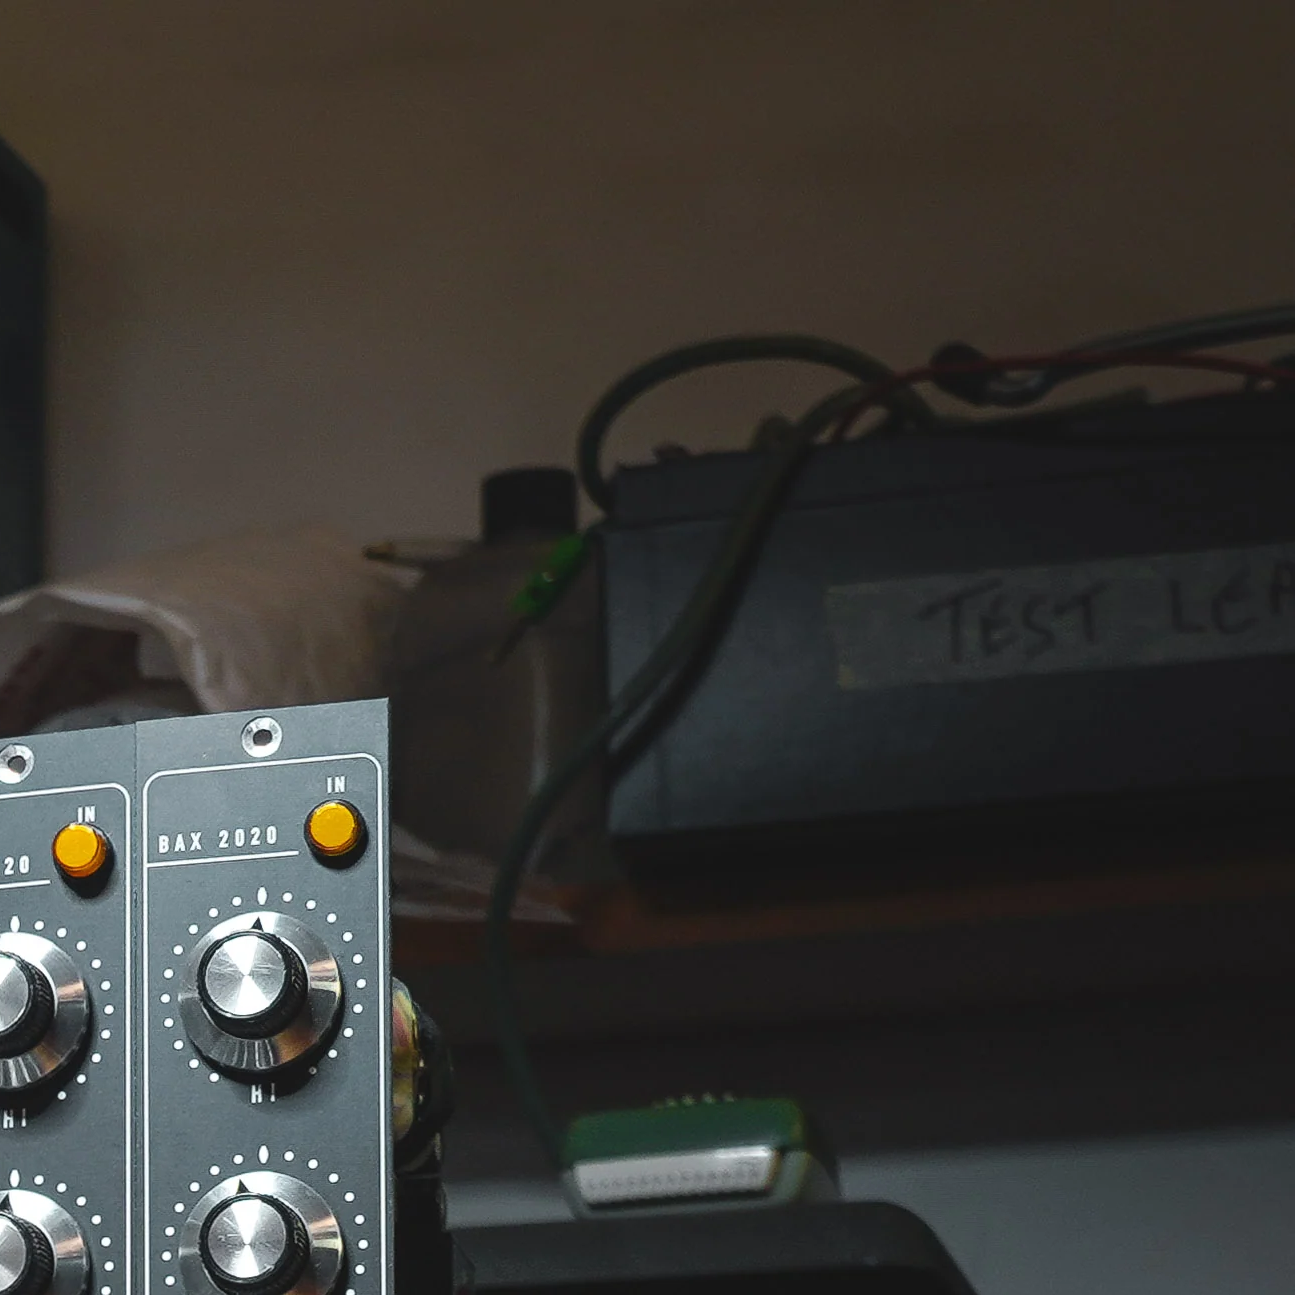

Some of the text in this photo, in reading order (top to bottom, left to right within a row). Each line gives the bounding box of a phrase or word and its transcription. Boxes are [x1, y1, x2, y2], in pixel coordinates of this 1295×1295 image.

[916, 576, 1108, 663] TEST
[326, 775, 346, 794] IN
[76, 805, 96, 825] IN
[158, 825, 277, 854] BAX 2020
[250, 1081, 276, 1104] HI
[2, 1108, 27, 1130] HI
